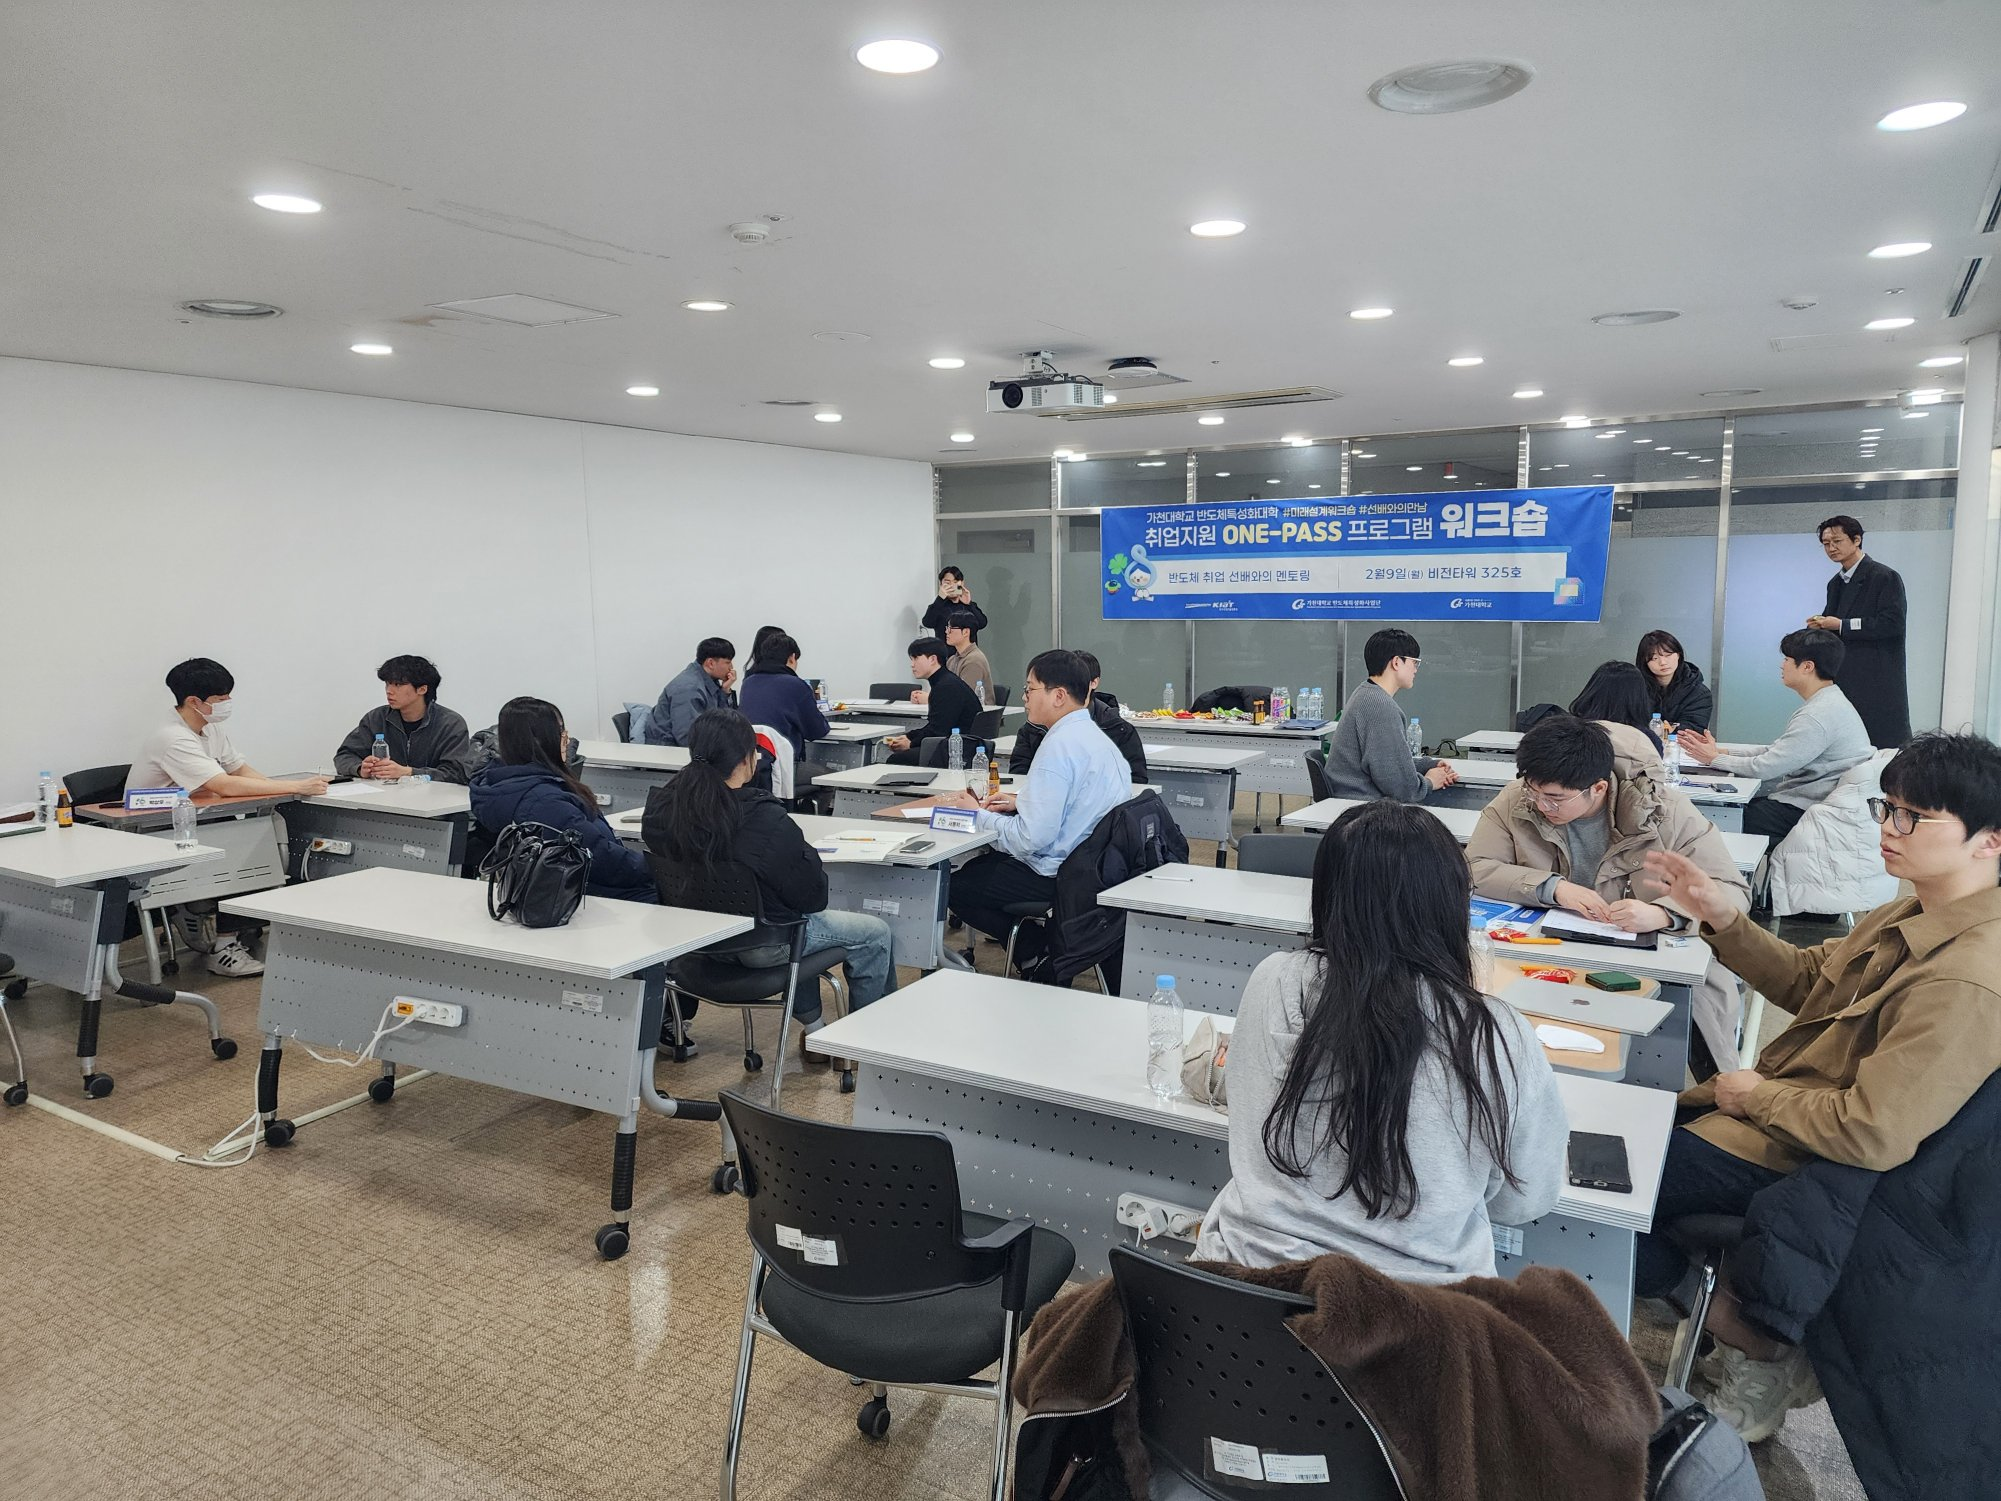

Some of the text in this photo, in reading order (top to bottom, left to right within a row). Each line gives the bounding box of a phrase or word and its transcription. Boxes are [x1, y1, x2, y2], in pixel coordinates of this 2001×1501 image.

[1146, 503, 1427, 524] 가천대학교 반도체특성화대학 #미래설계워크숍 #선배와의만남
[1145, 500, 1548, 547] 취업지원 ONE-PASS 프로그램 워크숍
[1168, 570, 1310, 583] 반도체 취업 선배와의 멘토링
[1366, 567, 1522, 580] 2월9일(월) 비전타워 325호
